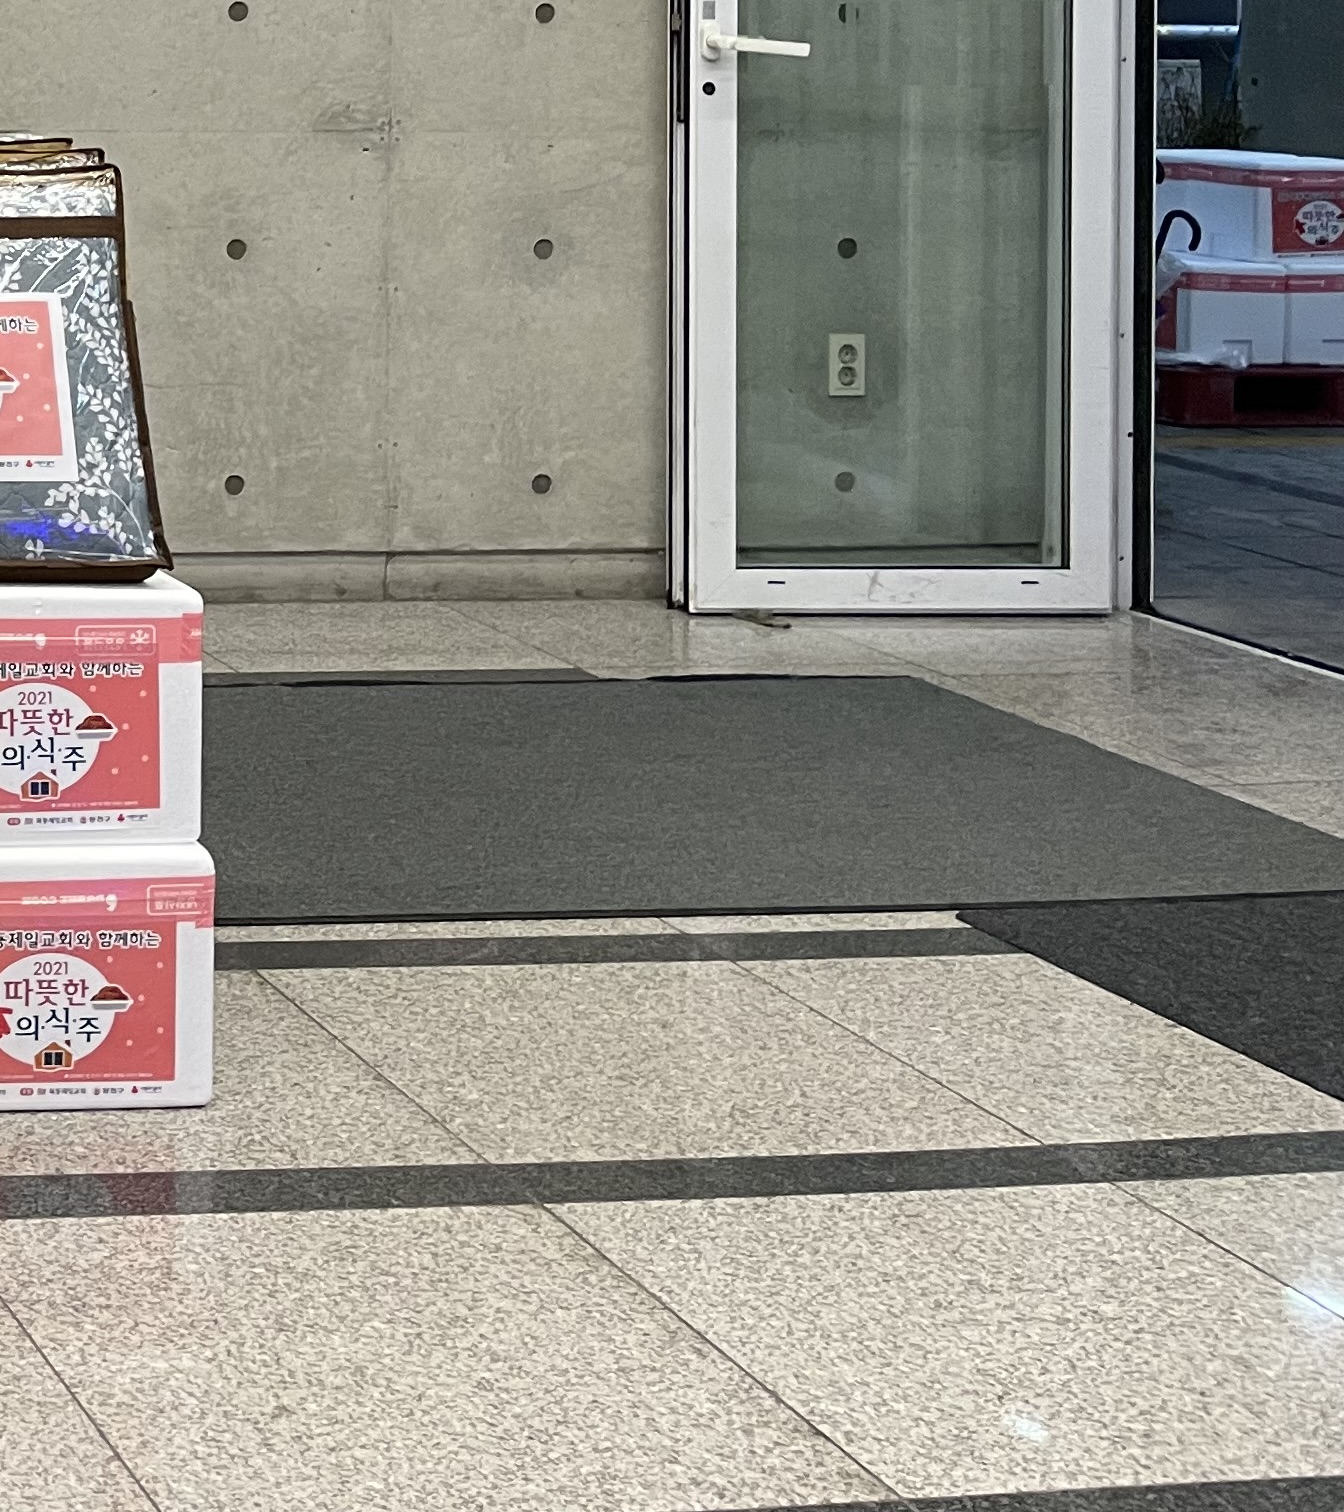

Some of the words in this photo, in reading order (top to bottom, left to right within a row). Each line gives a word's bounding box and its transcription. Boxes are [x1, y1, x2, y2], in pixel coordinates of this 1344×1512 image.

[17, 690, 53, 706] 2021
[1, 737, 87, 771] 의·식·주
[98, 931, 162, 948] 함께하는
[32, 961, 69, 976] 2021
[4, 978, 90, 1008] 따뜻한
[14, 1008, 102, 1042] 의·식·주
